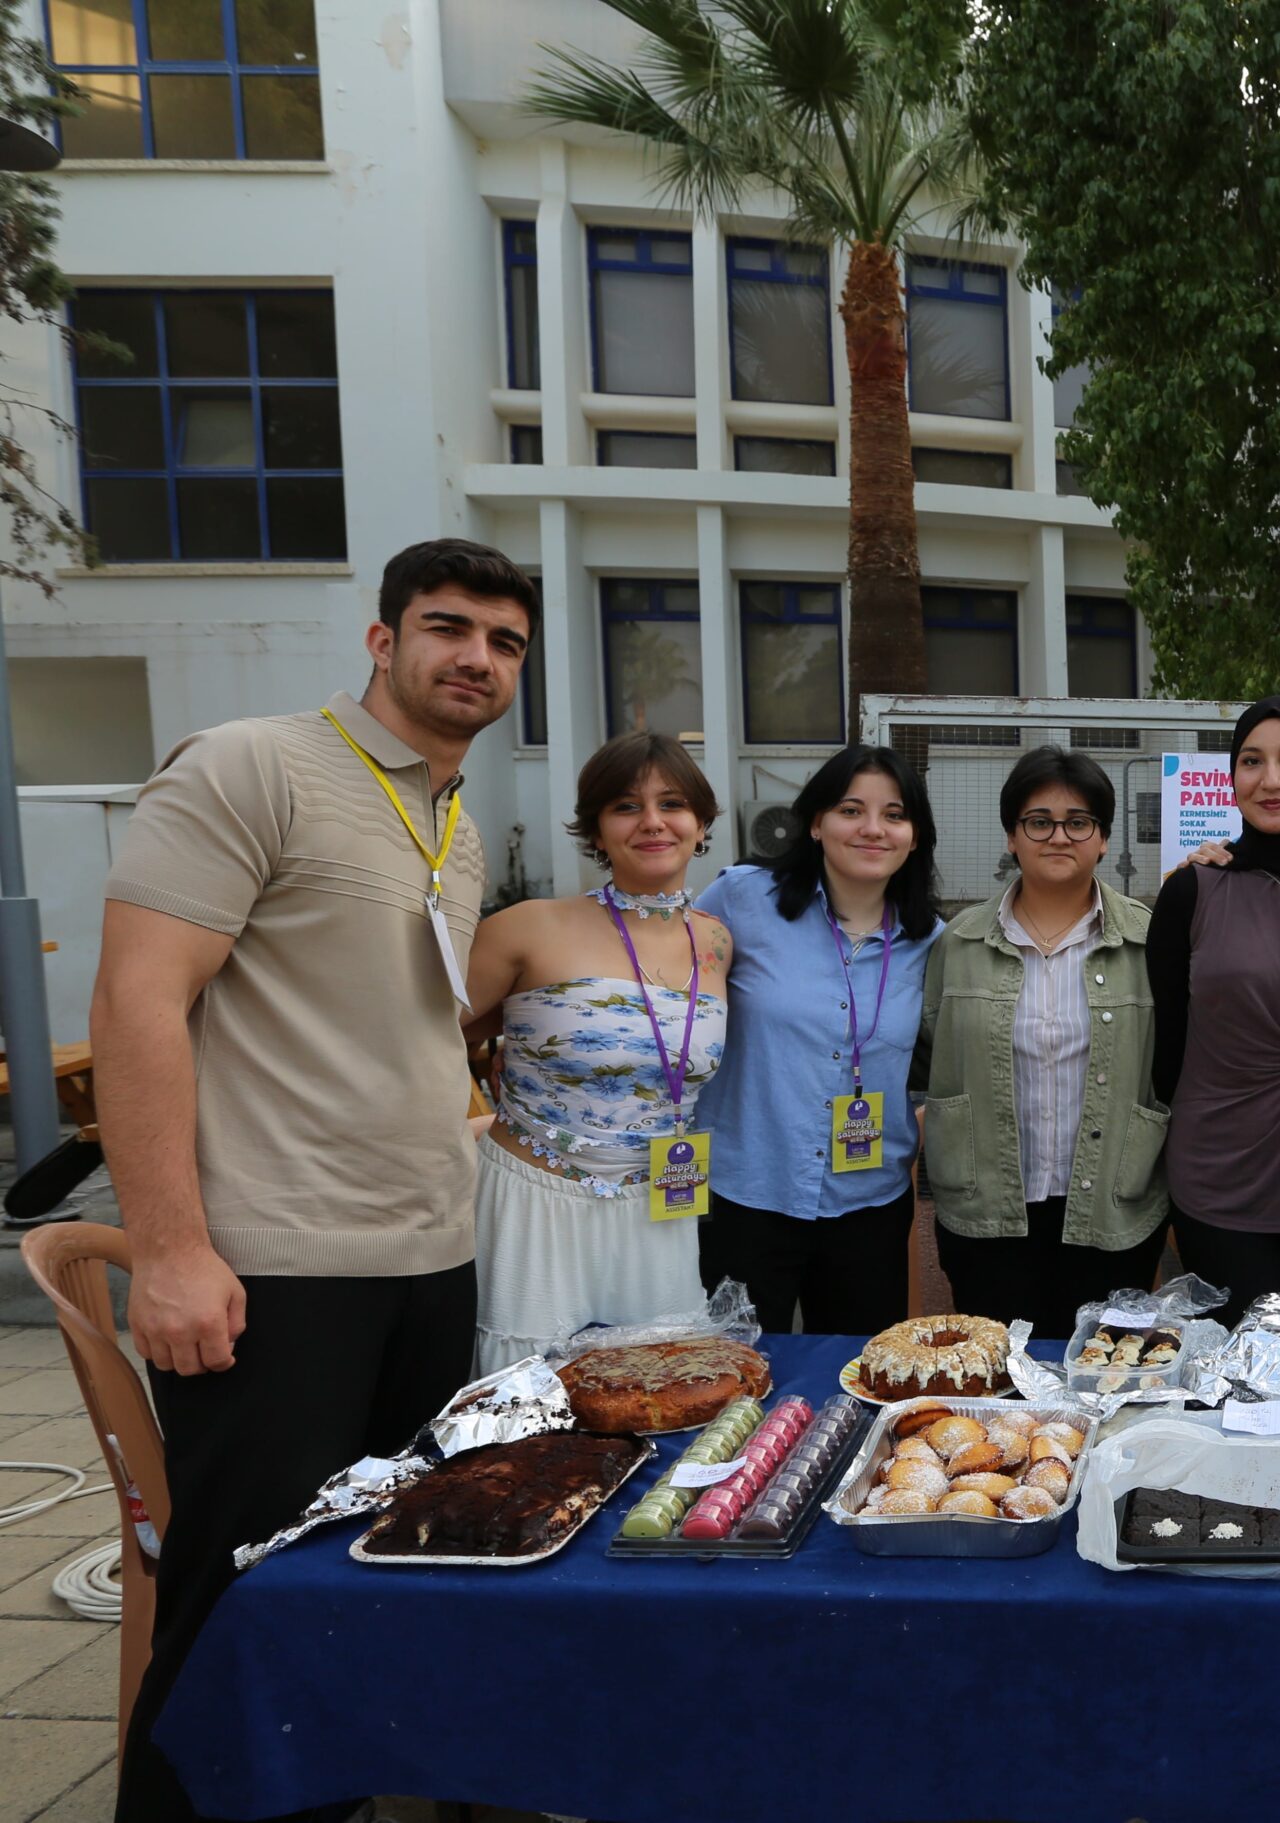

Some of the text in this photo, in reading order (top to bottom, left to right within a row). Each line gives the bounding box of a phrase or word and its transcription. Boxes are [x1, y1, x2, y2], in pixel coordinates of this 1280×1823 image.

[1181, 769, 1235, 788] SEVİM
[1180, 809, 1228, 818] KERMESİMİZ
[1180, 819, 1207, 827] SOKAK
[1180, 829, 1231, 838] HAYVANLARI
[843, 1119, 873, 1129] Happy
[837, 1129, 880, 1140] Saturdays
[663, 1163, 697, 1175] Happy
[654, 1173, 706, 1186] Saturdays
